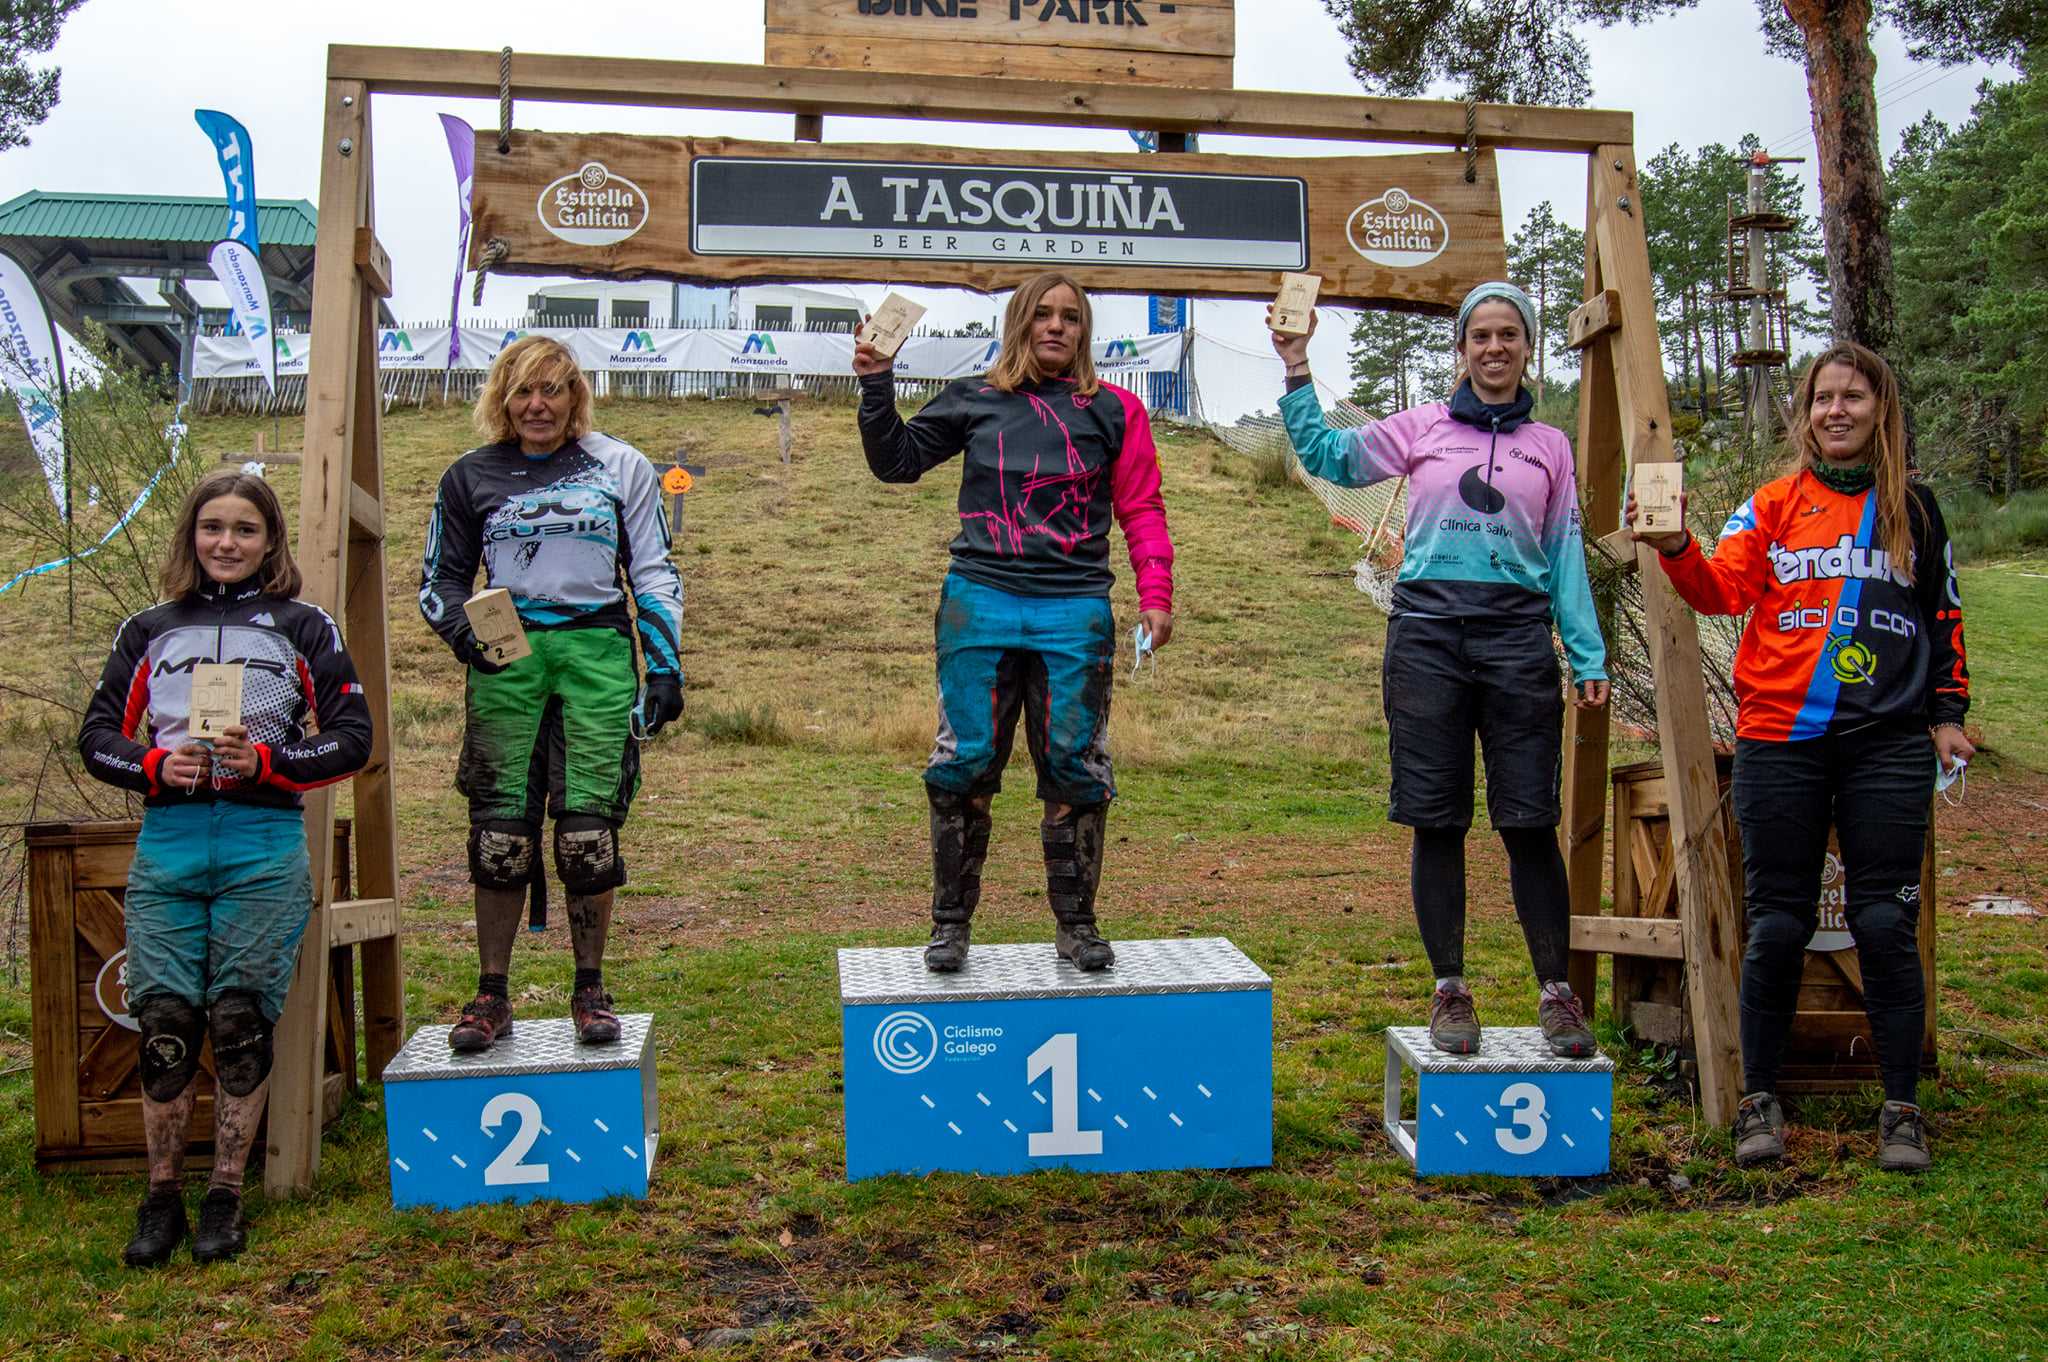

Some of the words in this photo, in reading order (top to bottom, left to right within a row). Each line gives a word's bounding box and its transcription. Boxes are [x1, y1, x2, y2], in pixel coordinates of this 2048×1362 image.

[555, 187, 634, 207] Estrella
[820, 176, 863, 221] A
[882, 176, 1185, 232] TASQUIÑA
[558, 206, 629, 227] Galicia
[1361, 211, 1435, 231] Estrella
[873, 235, 957, 250] BEER
[992, 238, 1134, 255] GARDEN
[1365, 229, 1432, 249] Galicia
[1279, 315, 1288, 326] 3
[609, 354, 668, 364] Manzaneda
[730, 356, 788, 366] Manzaneda
[1439, 518, 1481, 533] Clínica
[1645, 514, 1654, 526] 5
[495, 647, 505, 660] 2
[944, 1024, 1003, 1039] Ciclismo
[944, 1041, 997, 1056] Galego
[1026, 1033, 1104, 1157] 1
[1495, 1082, 1548, 1155] 3
[480, 1092, 550, 1186] 2
